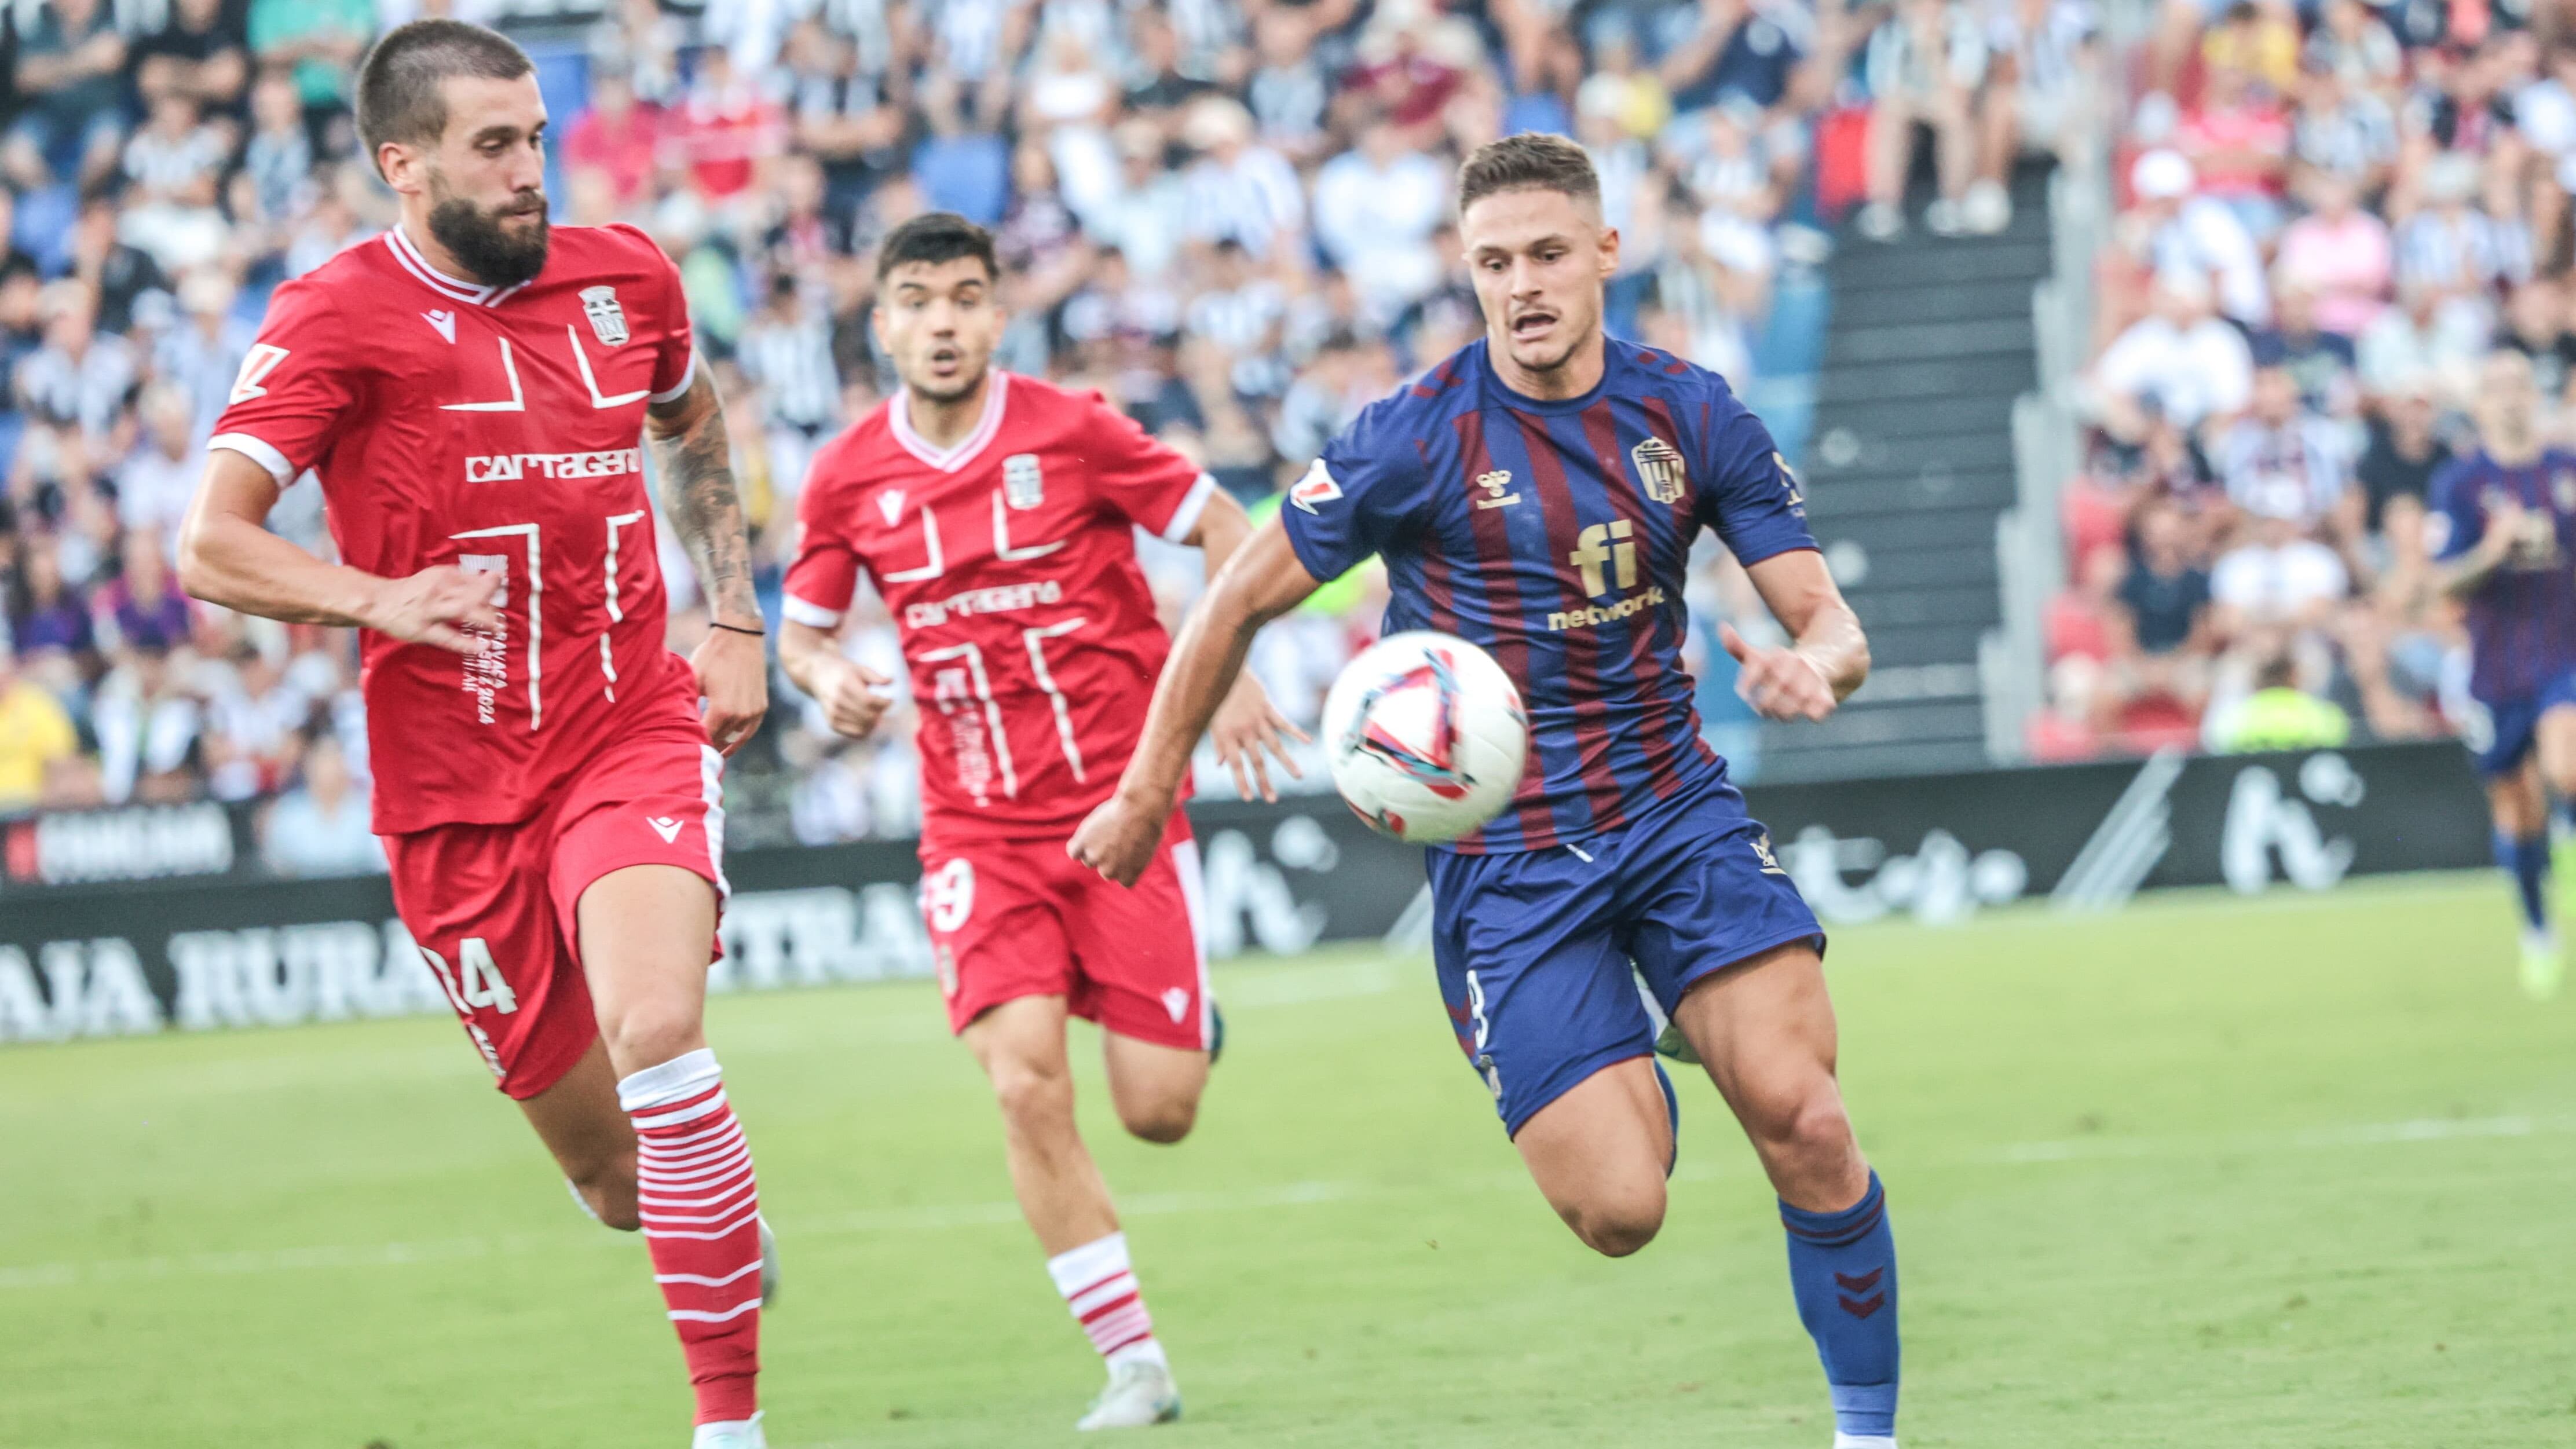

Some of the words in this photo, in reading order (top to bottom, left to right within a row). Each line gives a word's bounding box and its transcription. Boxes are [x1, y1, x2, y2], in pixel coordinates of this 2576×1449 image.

[1569, 519, 1637, 598] fi
[1547, 586, 1665, 631] network
[477, 687, 495, 724] 2024
